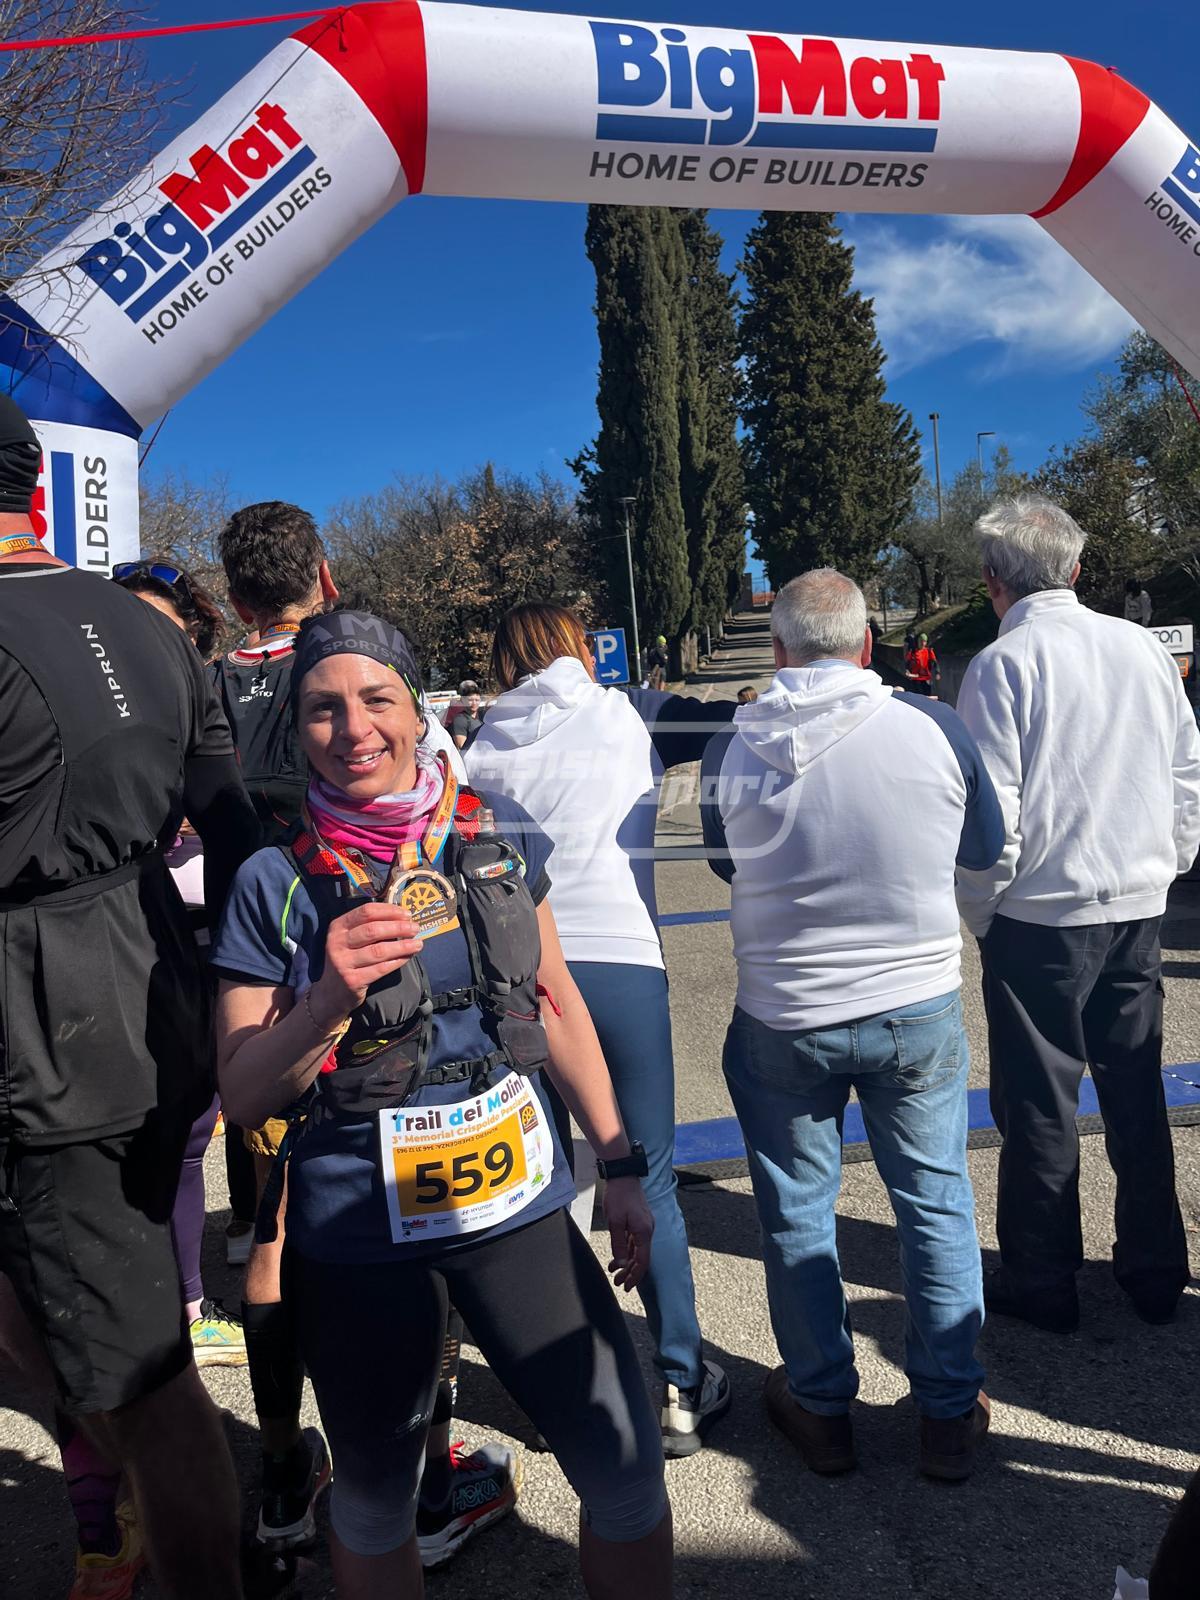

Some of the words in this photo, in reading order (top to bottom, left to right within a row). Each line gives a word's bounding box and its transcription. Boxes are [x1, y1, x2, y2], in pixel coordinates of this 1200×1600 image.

[588, 21, 946, 146] BigMat
[589, 151, 700, 181] HOME
[709, 156, 759, 183] OF
[764, 159, 929, 188] BUILDERS
[76, 102, 303, 306] BigMat
[1144, 191, 1197, 244] HOME
[142, 281, 209, 344] HOME
[206, 253, 236, 285] OF
[234, 166, 332, 261] BUILDERS
[83, 455, 110, 577] LDERS
[80, 624, 131, 718] KIPRUN
[597, 634, 618, 663] P
[393, 1109, 442, 1132] Trail
[449, 1100, 482, 1126] dei
[487, 1078, 525, 1112] Molini
[405, 1129, 454, 1143] Memorial
[457, 1114, 499, 1136] Crispoldo
[416, 1141, 514, 1204] 559
[452, 1478, 501, 1514] HOKA
